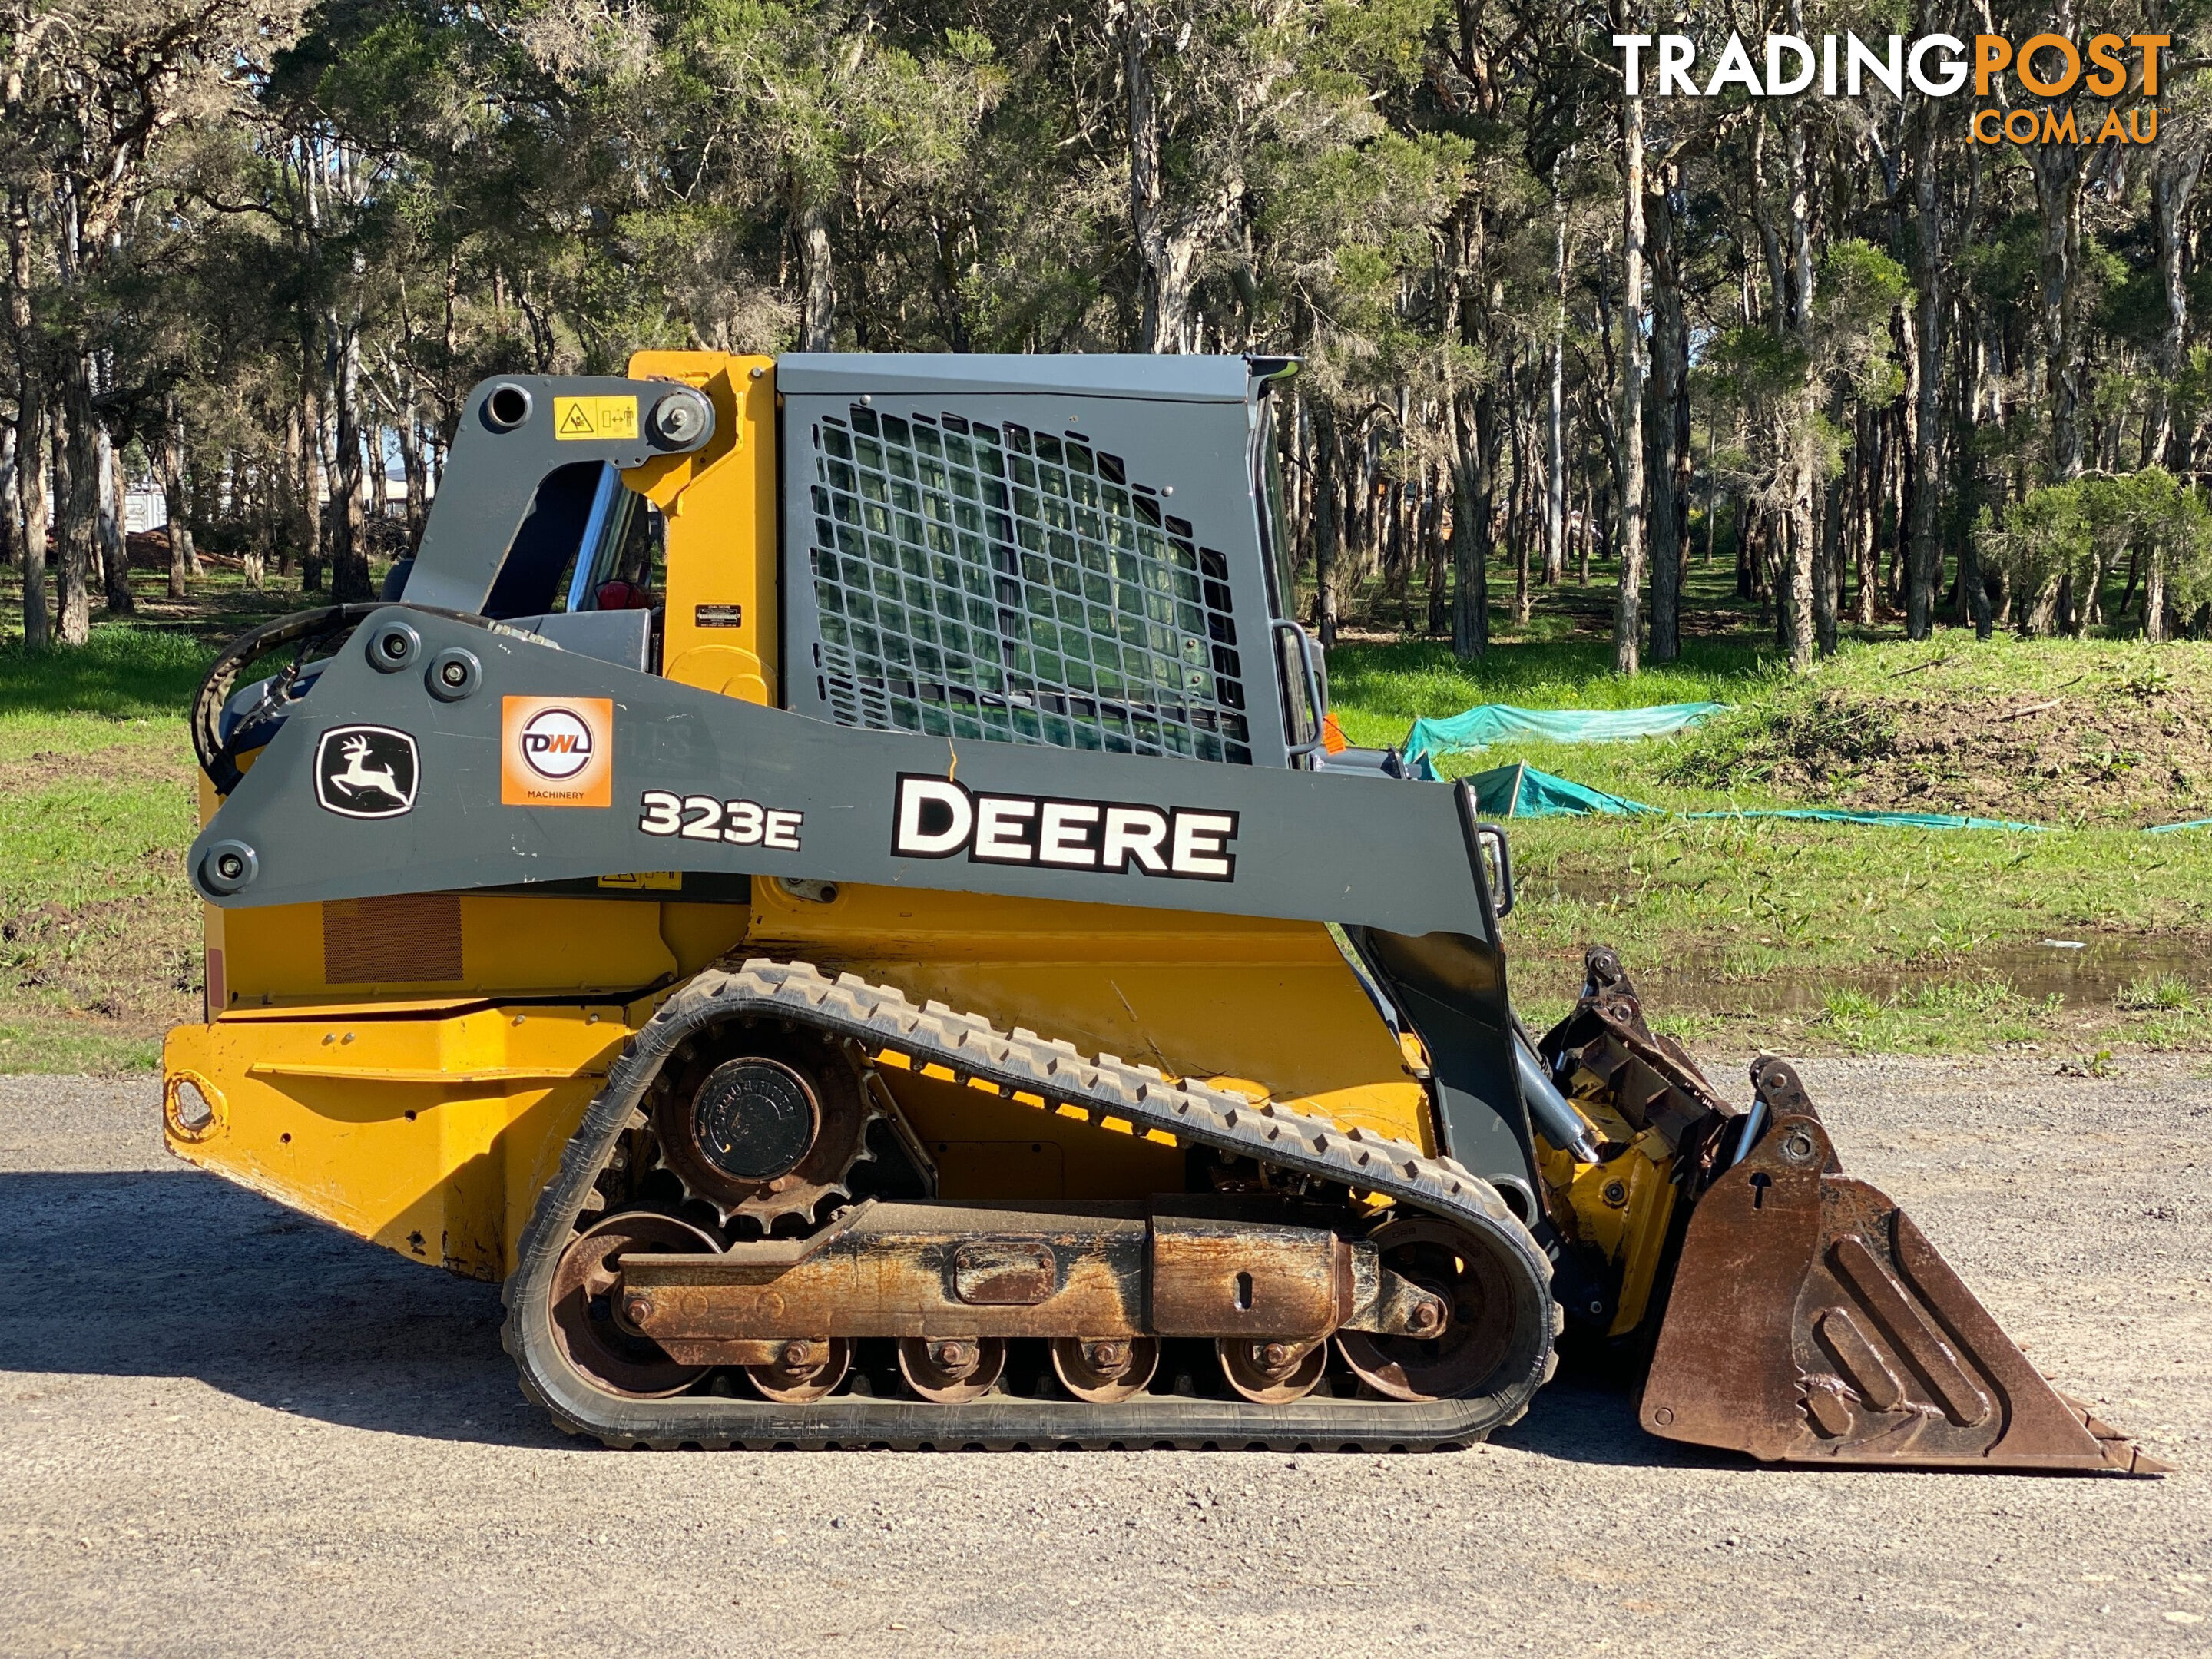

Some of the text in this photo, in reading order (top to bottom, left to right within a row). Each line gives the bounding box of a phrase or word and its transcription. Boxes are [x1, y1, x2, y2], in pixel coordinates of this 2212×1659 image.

[525, 733, 590, 754] DWL
[527, 790, 585, 800] MACHINERY
[639, 790, 803, 851] 323E
[892, 773, 1238, 881] DEERE
